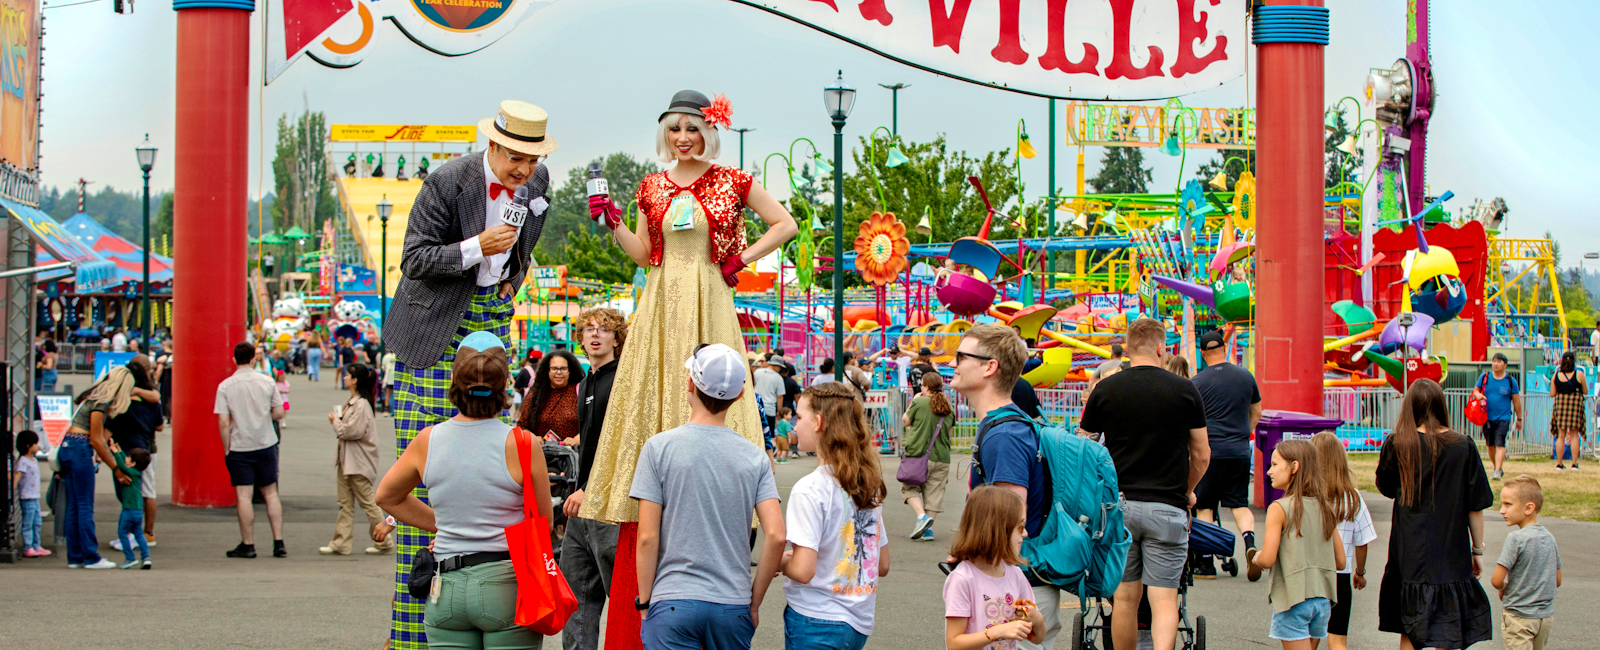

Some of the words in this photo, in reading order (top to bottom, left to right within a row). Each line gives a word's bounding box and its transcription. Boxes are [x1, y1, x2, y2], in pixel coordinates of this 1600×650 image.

[443, 0, 502, 9] CELEBRATION
[807, 0, 1228, 80] VILLE
[1068, 99, 1161, 144] CRAZY
[1163, 97, 1256, 145] COASTE
[503, 207, 525, 224] WSF
[532, 267, 557, 277] TILT-A-
[538, 278, 561, 288] WHIRL
